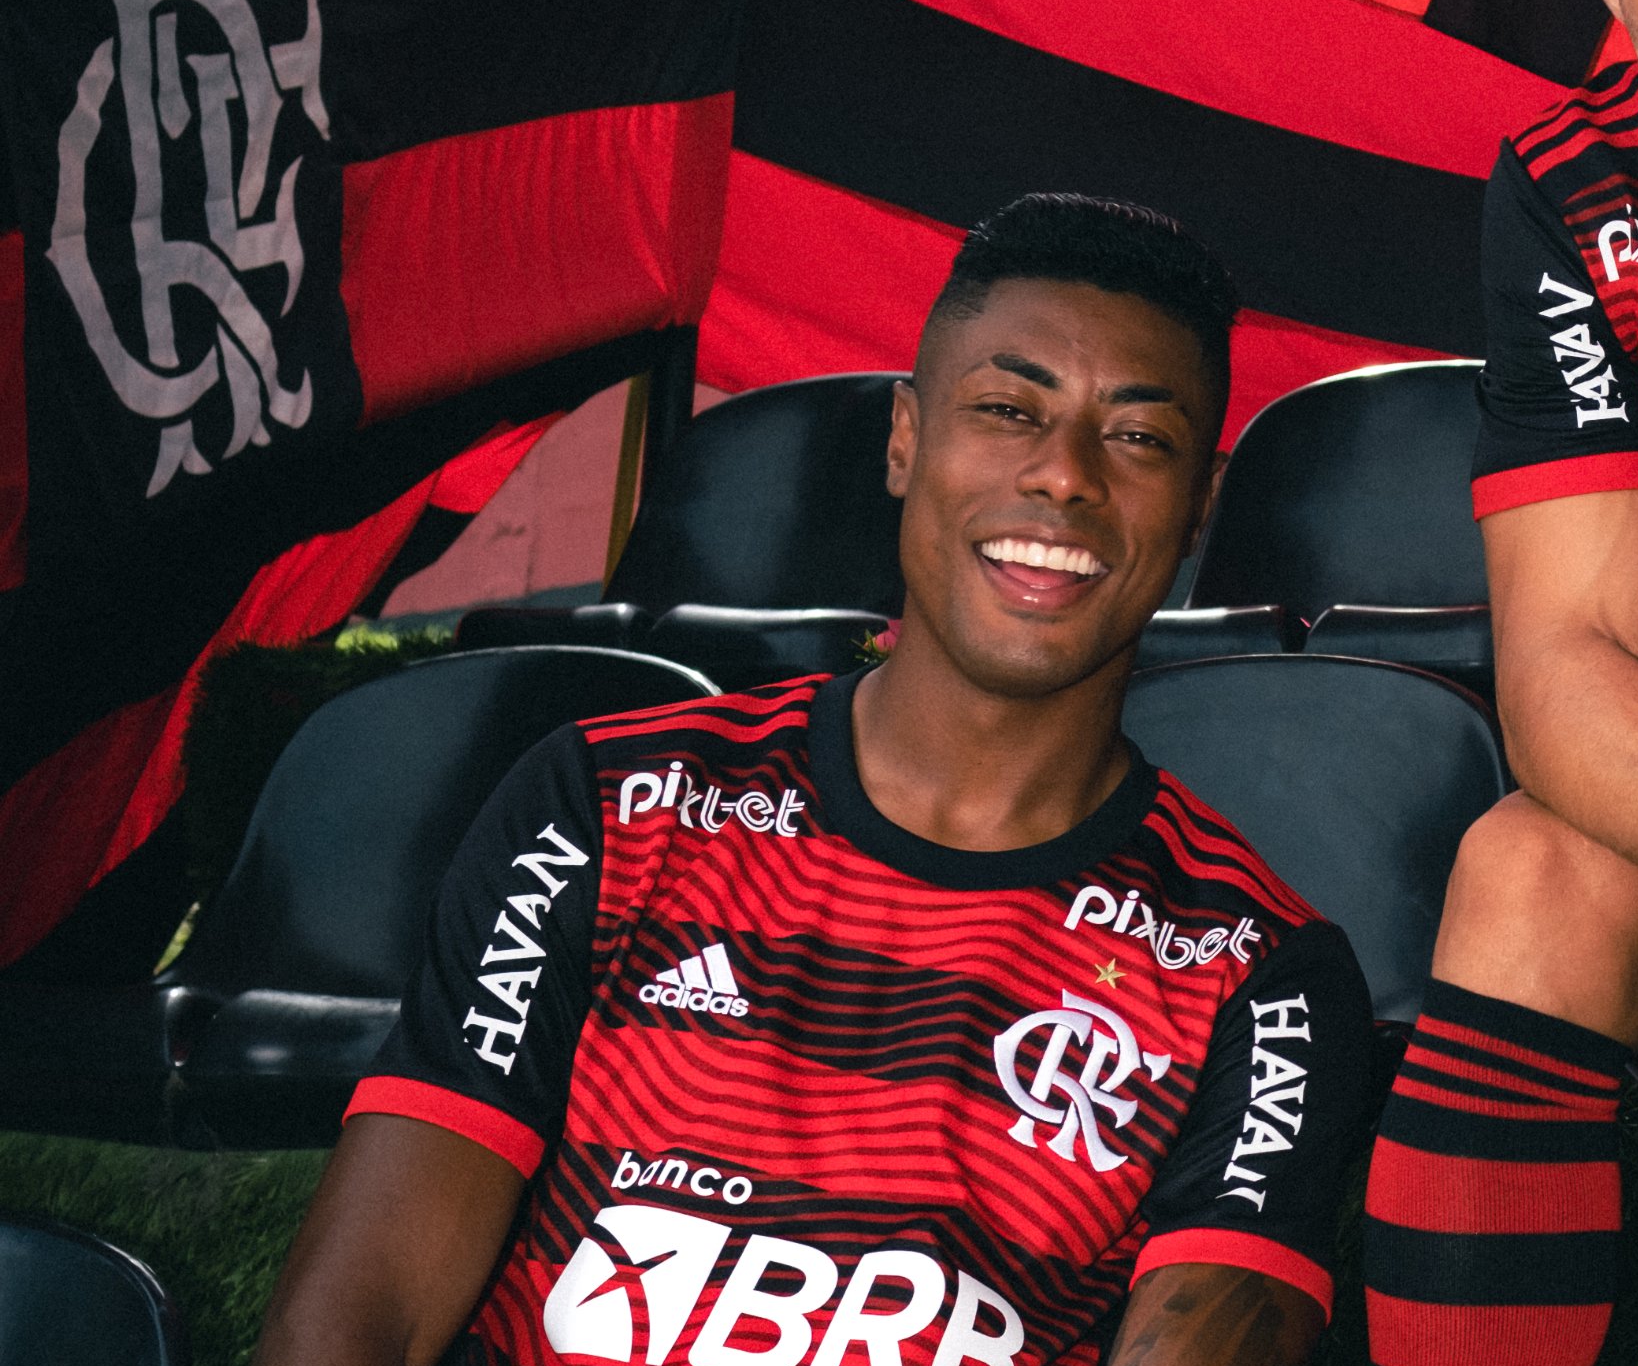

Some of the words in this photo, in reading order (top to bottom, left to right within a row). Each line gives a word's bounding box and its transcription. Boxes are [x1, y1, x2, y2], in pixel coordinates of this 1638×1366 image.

[618, 760, 806, 838] pixbet
[462, 822, 590, 1076] HAVAN
[1063, 885, 1262, 973] pixbet
[638, 981, 750, 1017] adidas
[610, 1151, 753, 1205] banco
